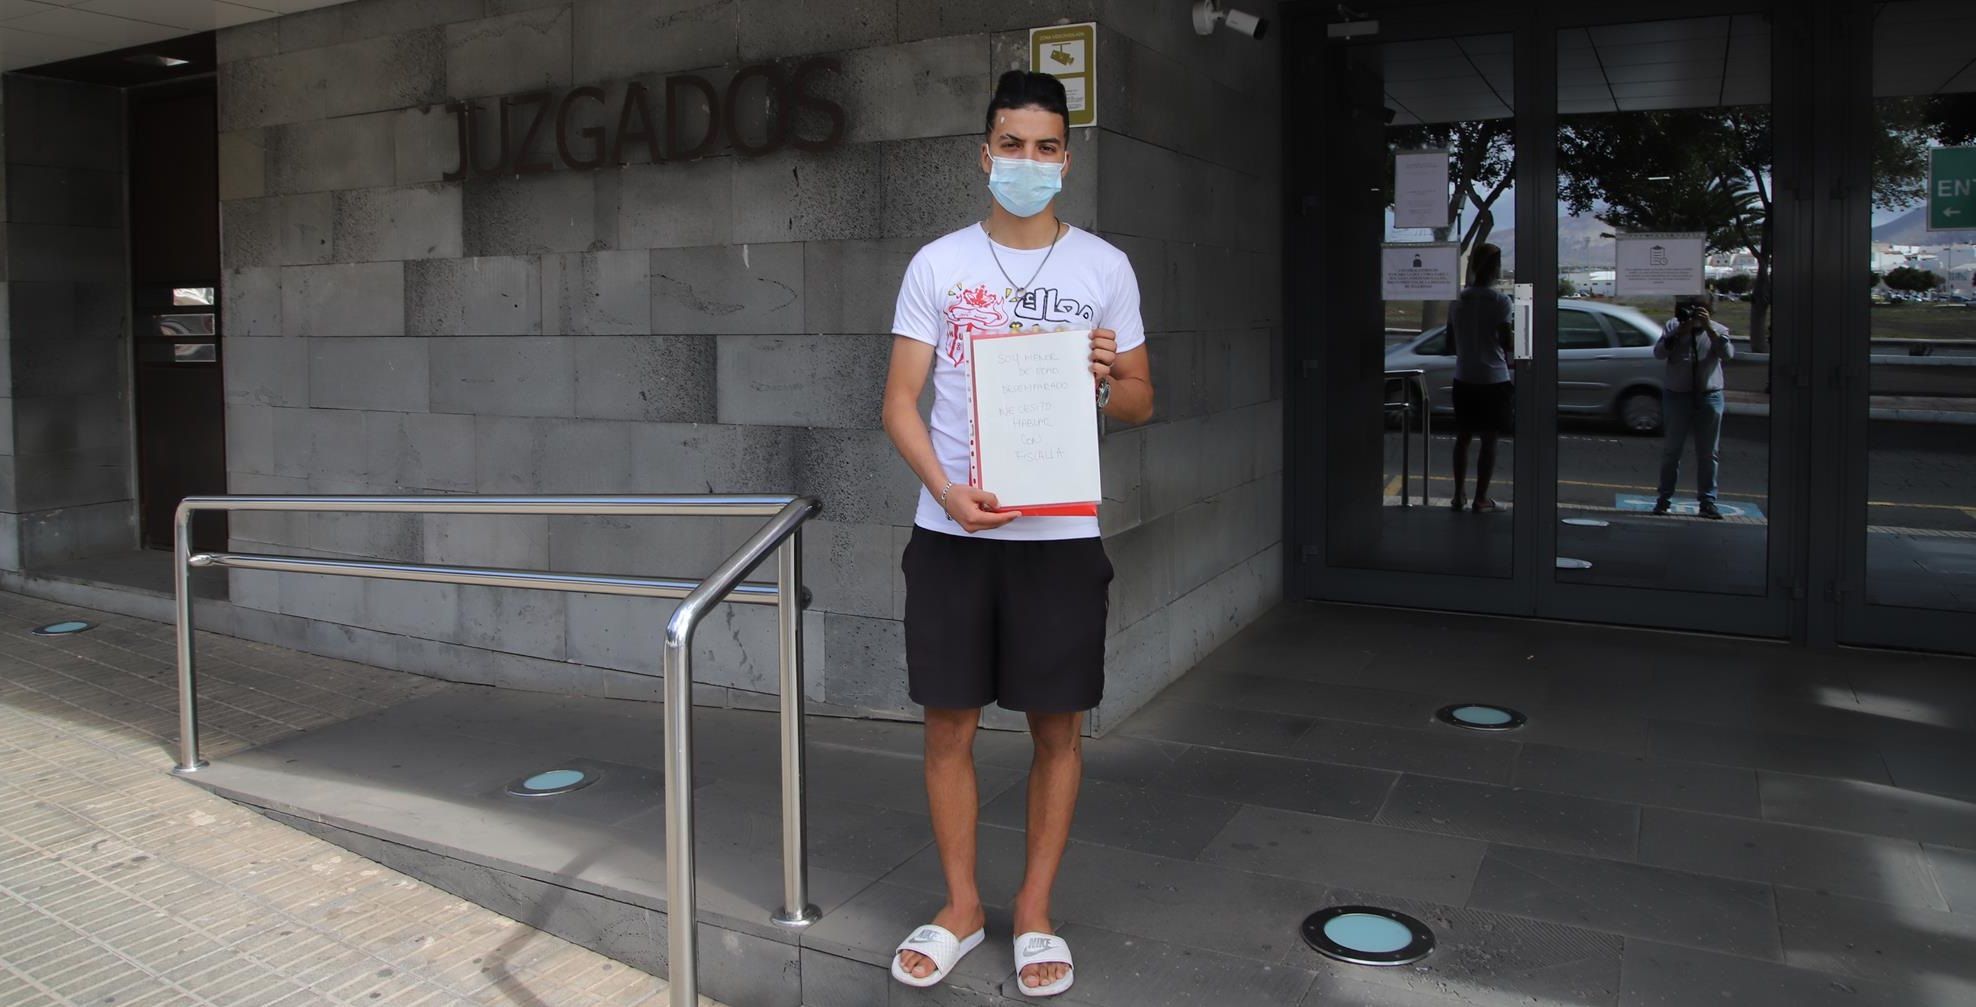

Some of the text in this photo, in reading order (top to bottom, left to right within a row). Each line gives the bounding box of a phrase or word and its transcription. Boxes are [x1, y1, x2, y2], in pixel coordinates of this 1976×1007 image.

[443, 57, 846, 181] JUZGADOS
[1938, 179, 1976, 197] EN
[1028, 938, 1052, 949] NIKE
